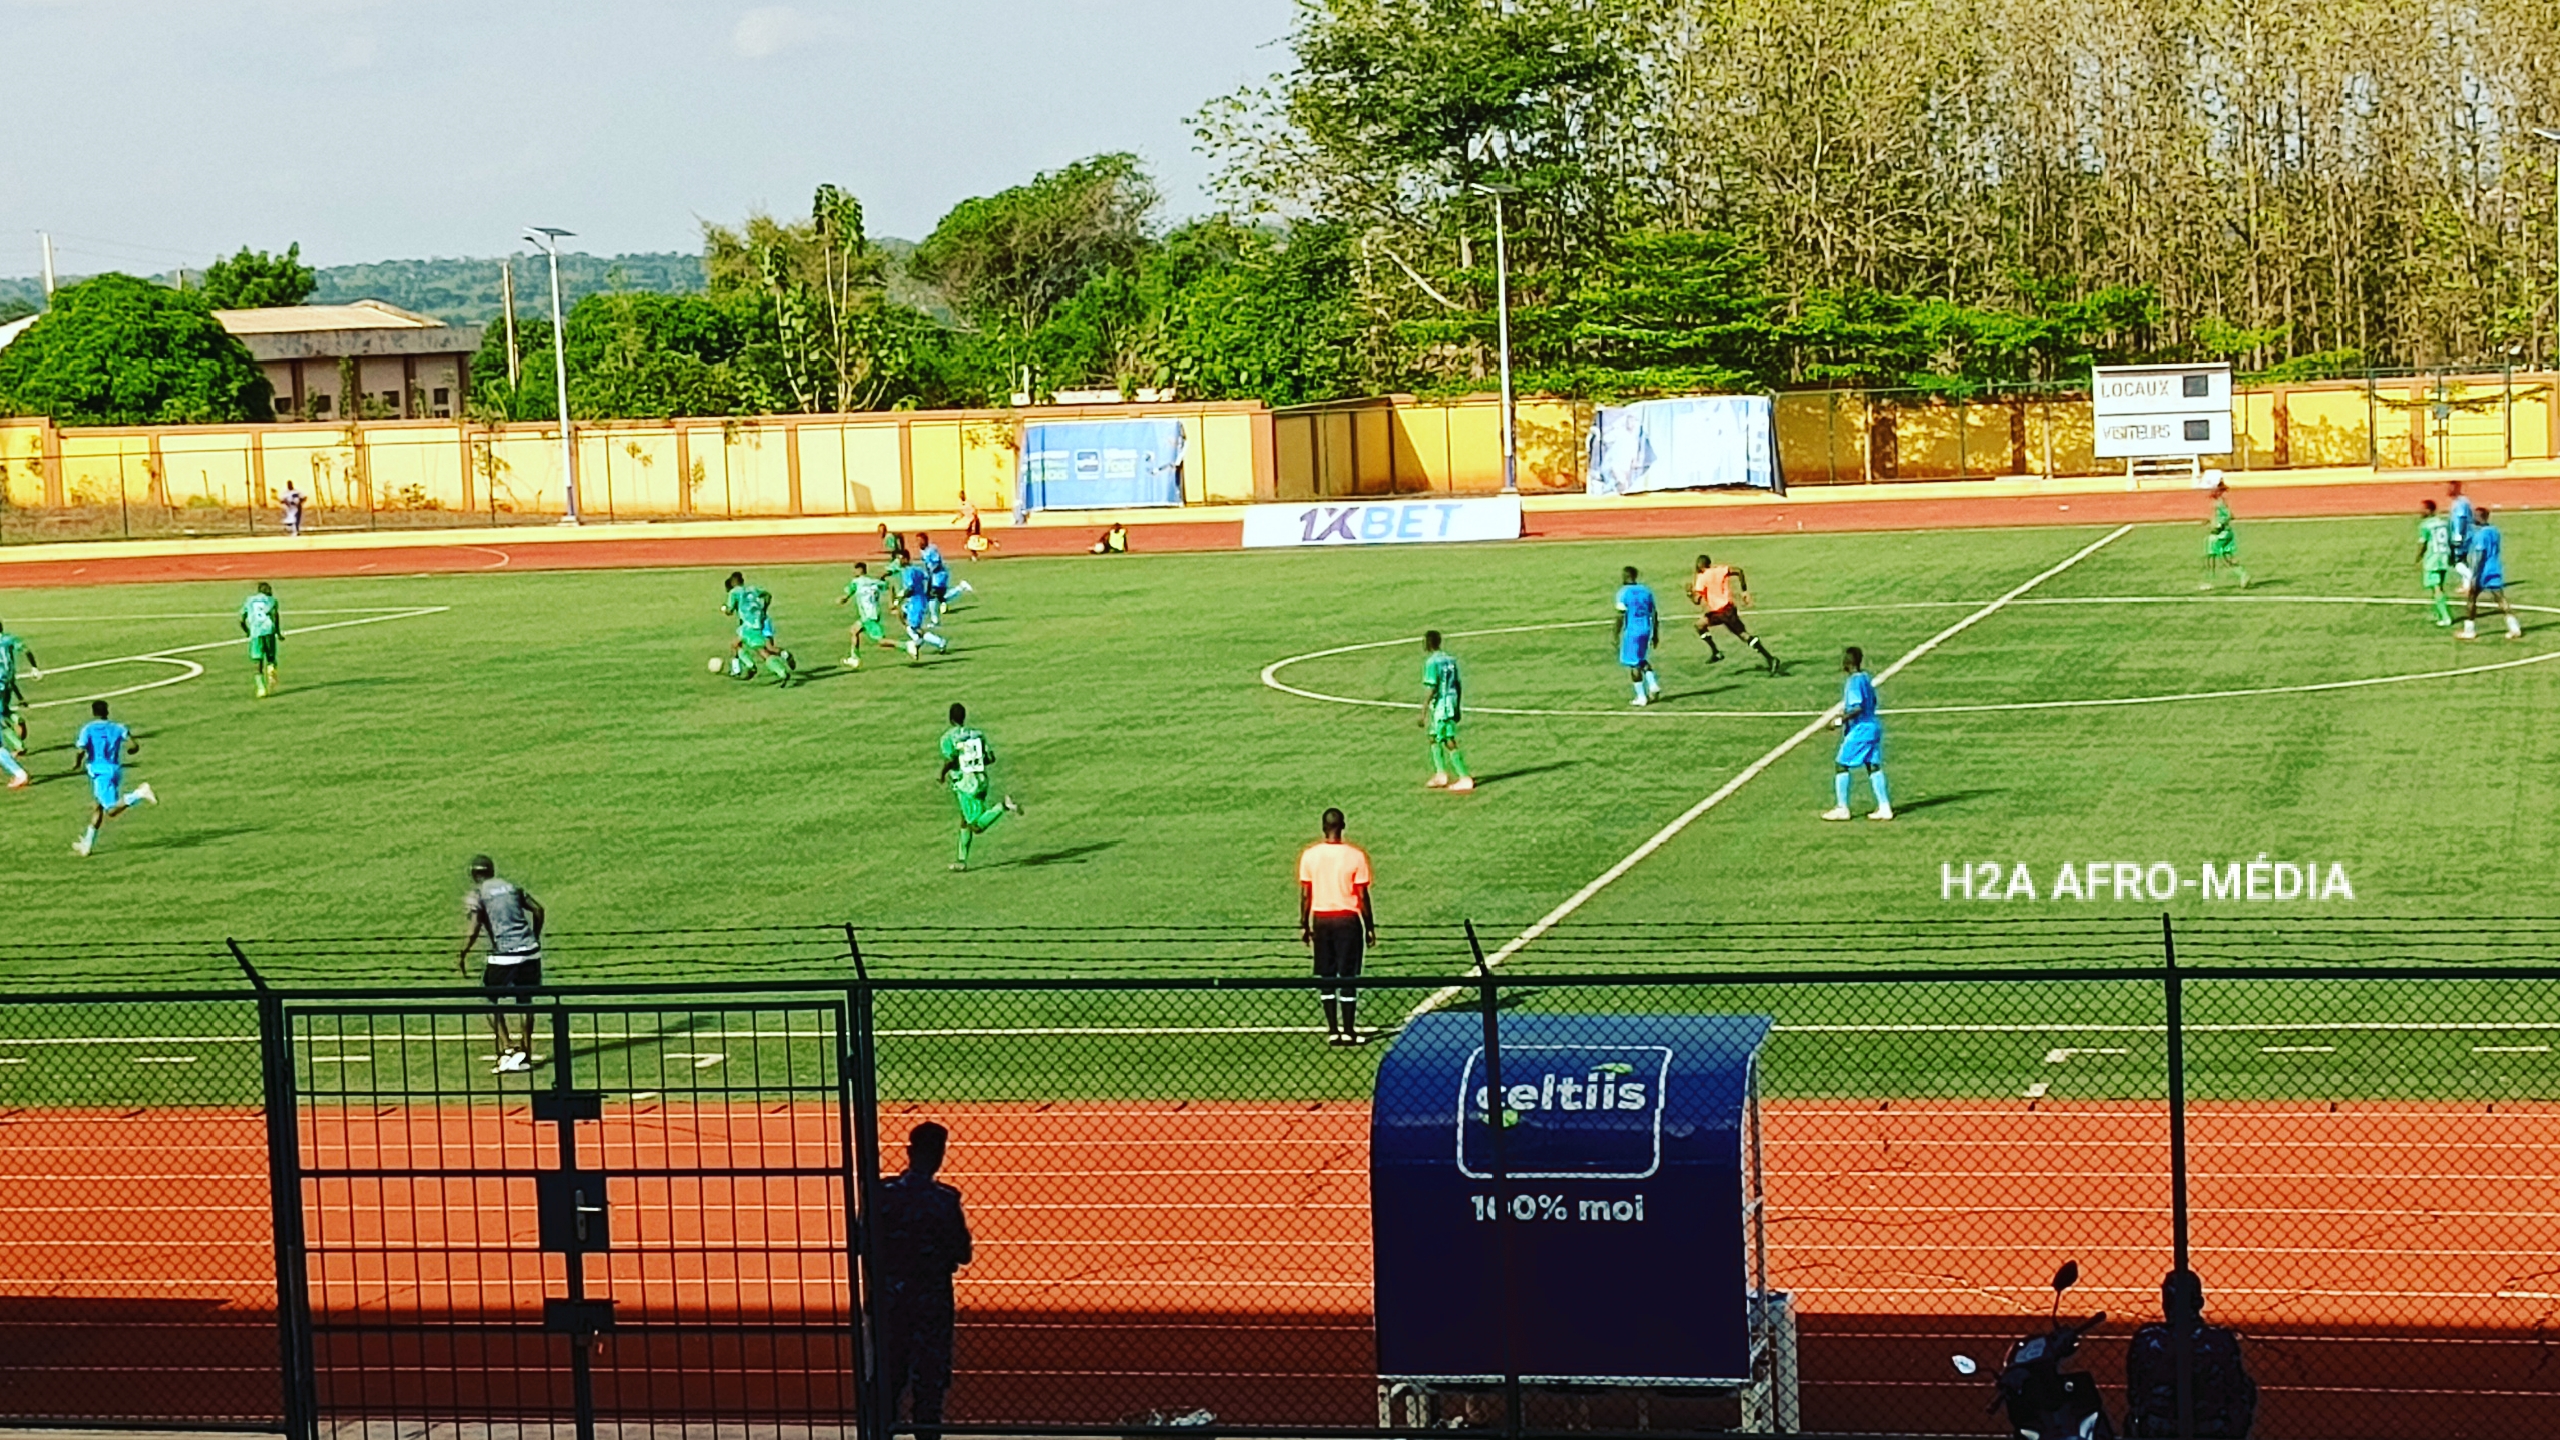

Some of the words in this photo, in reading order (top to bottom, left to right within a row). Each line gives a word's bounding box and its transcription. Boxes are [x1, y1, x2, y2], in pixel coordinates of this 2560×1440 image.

[2101, 380, 2170, 398] LOCAUX
[2103, 425, 2171, 440] VISITEURS
[1300, 504, 1463, 541] 1XBET
[1579, 1194, 1644, 1221] moi
